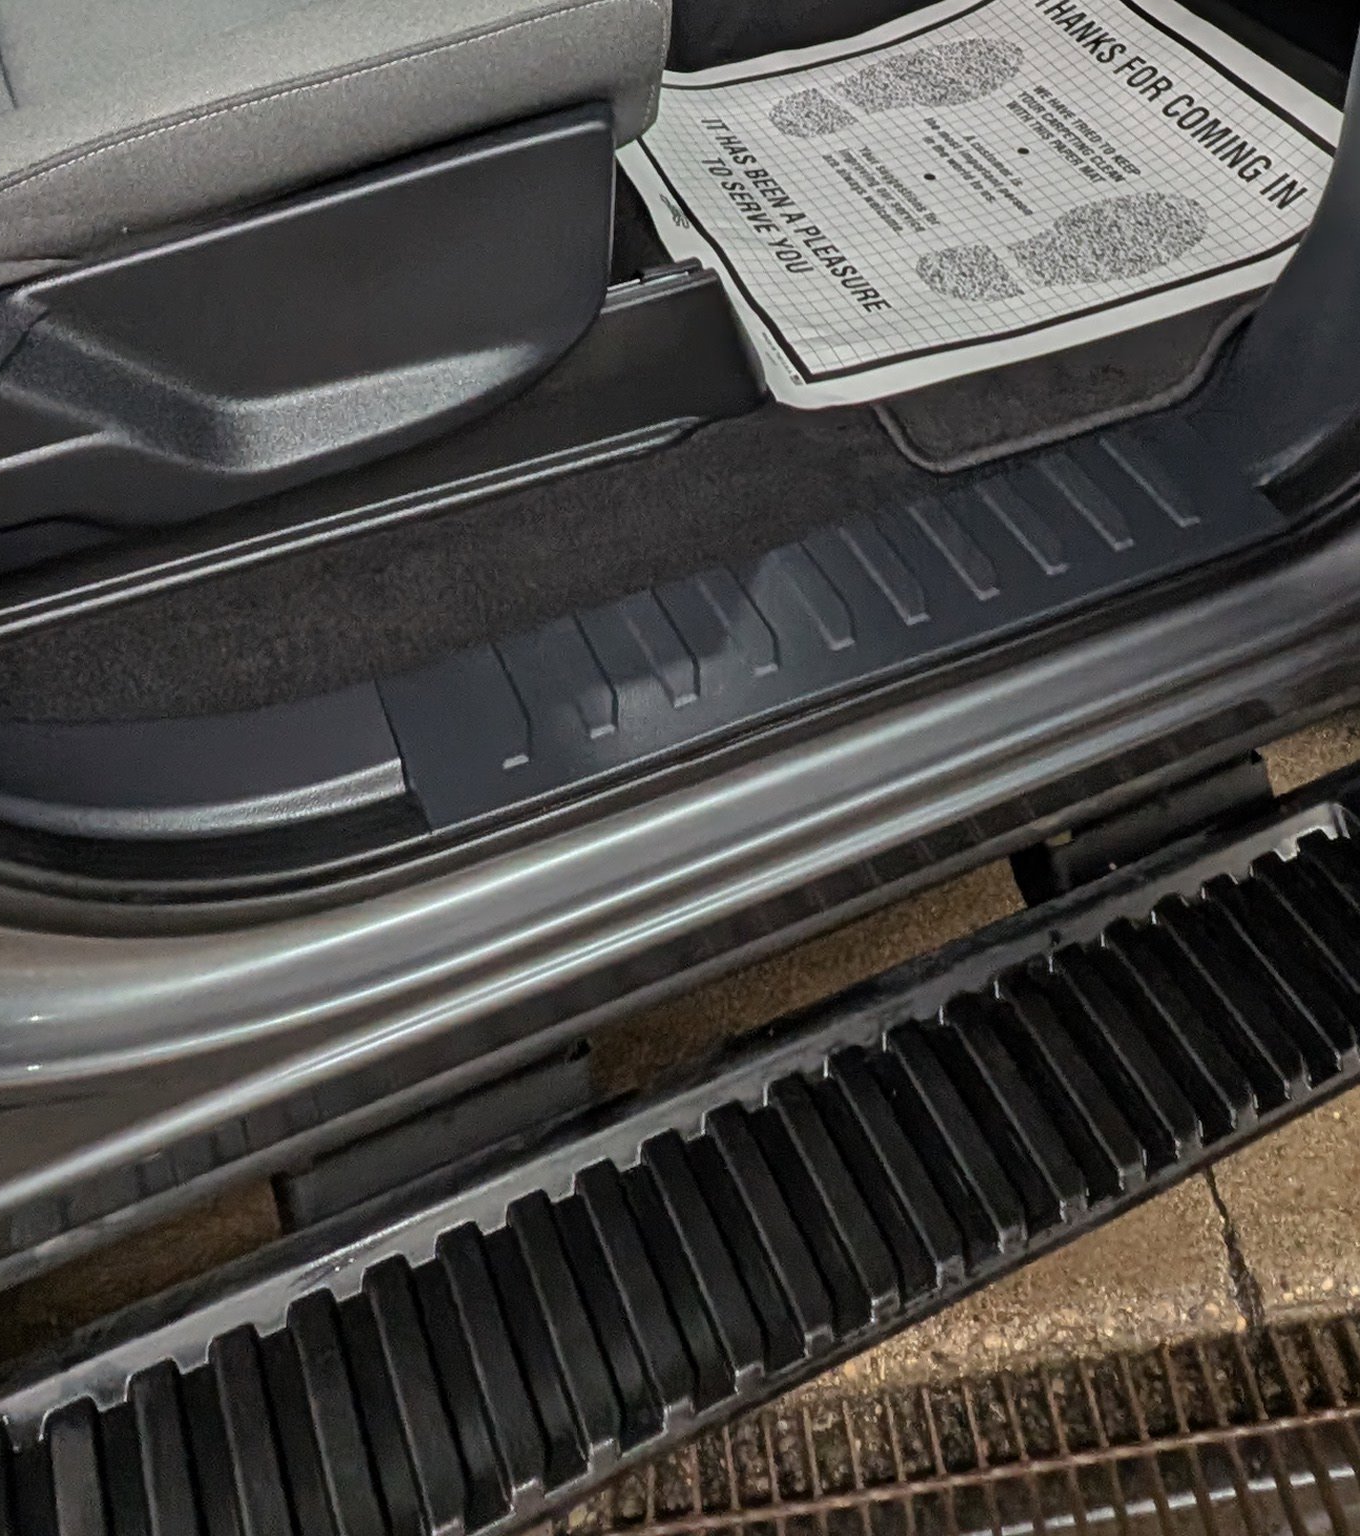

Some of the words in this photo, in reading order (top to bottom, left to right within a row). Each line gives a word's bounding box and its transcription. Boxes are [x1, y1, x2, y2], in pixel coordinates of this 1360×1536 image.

[700, 117, 730, 132] IT
[714, 136, 757, 165] HAS
[963, 134, 976, 143] A
[970, 142, 1014, 178] customer
[1010, 176, 1024, 188] is
[1006, 100, 1032, 124] WITH
[1029, 119, 1054, 140] THIS
[1050, 138, 1084, 167] PAPER
[1078, 164, 1106, 184] MAT
[1017, 91, 1046, 114] YOUR
[1042, 112, 1094, 157] CARPETING
[1090, 155, 1128, 183] CLEAN
[1033, 85, 1053, 100] WE
[1047, 94, 1076, 120] HAVE
[1071, 118, 1103, 144] TRIED
[1099, 139, 1116, 155] TO
[1111, 154, 1142, 176] KEEP
[1113, 55, 1173, 103] FOR
[1162, 94, 1272, 184] COMING
[1259, 172, 1308, 211] IN
[743, 167, 797, 208] BEEN
[822, 154, 841, 168] are
[834, 162, 868, 196] always
[838, 148, 880, 188] improving
[876, 187, 895, 202] our
[890, 200, 927, 233] service
[858, 145, 881, 164] Your
[876, 164, 928, 214] suggestions
[922, 211, 942, 226] for
[932, 144, 950, 159] the
[946, 157, 977, 182] world
[970, 179, 984, 191] to
[937, 130, 963, 150] most
[959, 149, 1004, 188] important
[996, 186, 1034, 216] person
[701, 156, 731, 178] TO
[721, 181, 780, 234] SERVE
[769, 237, 814, 275] YOU
[780, 211, 806, 224] A
[794, 226, 892, 314] PLEASURE
